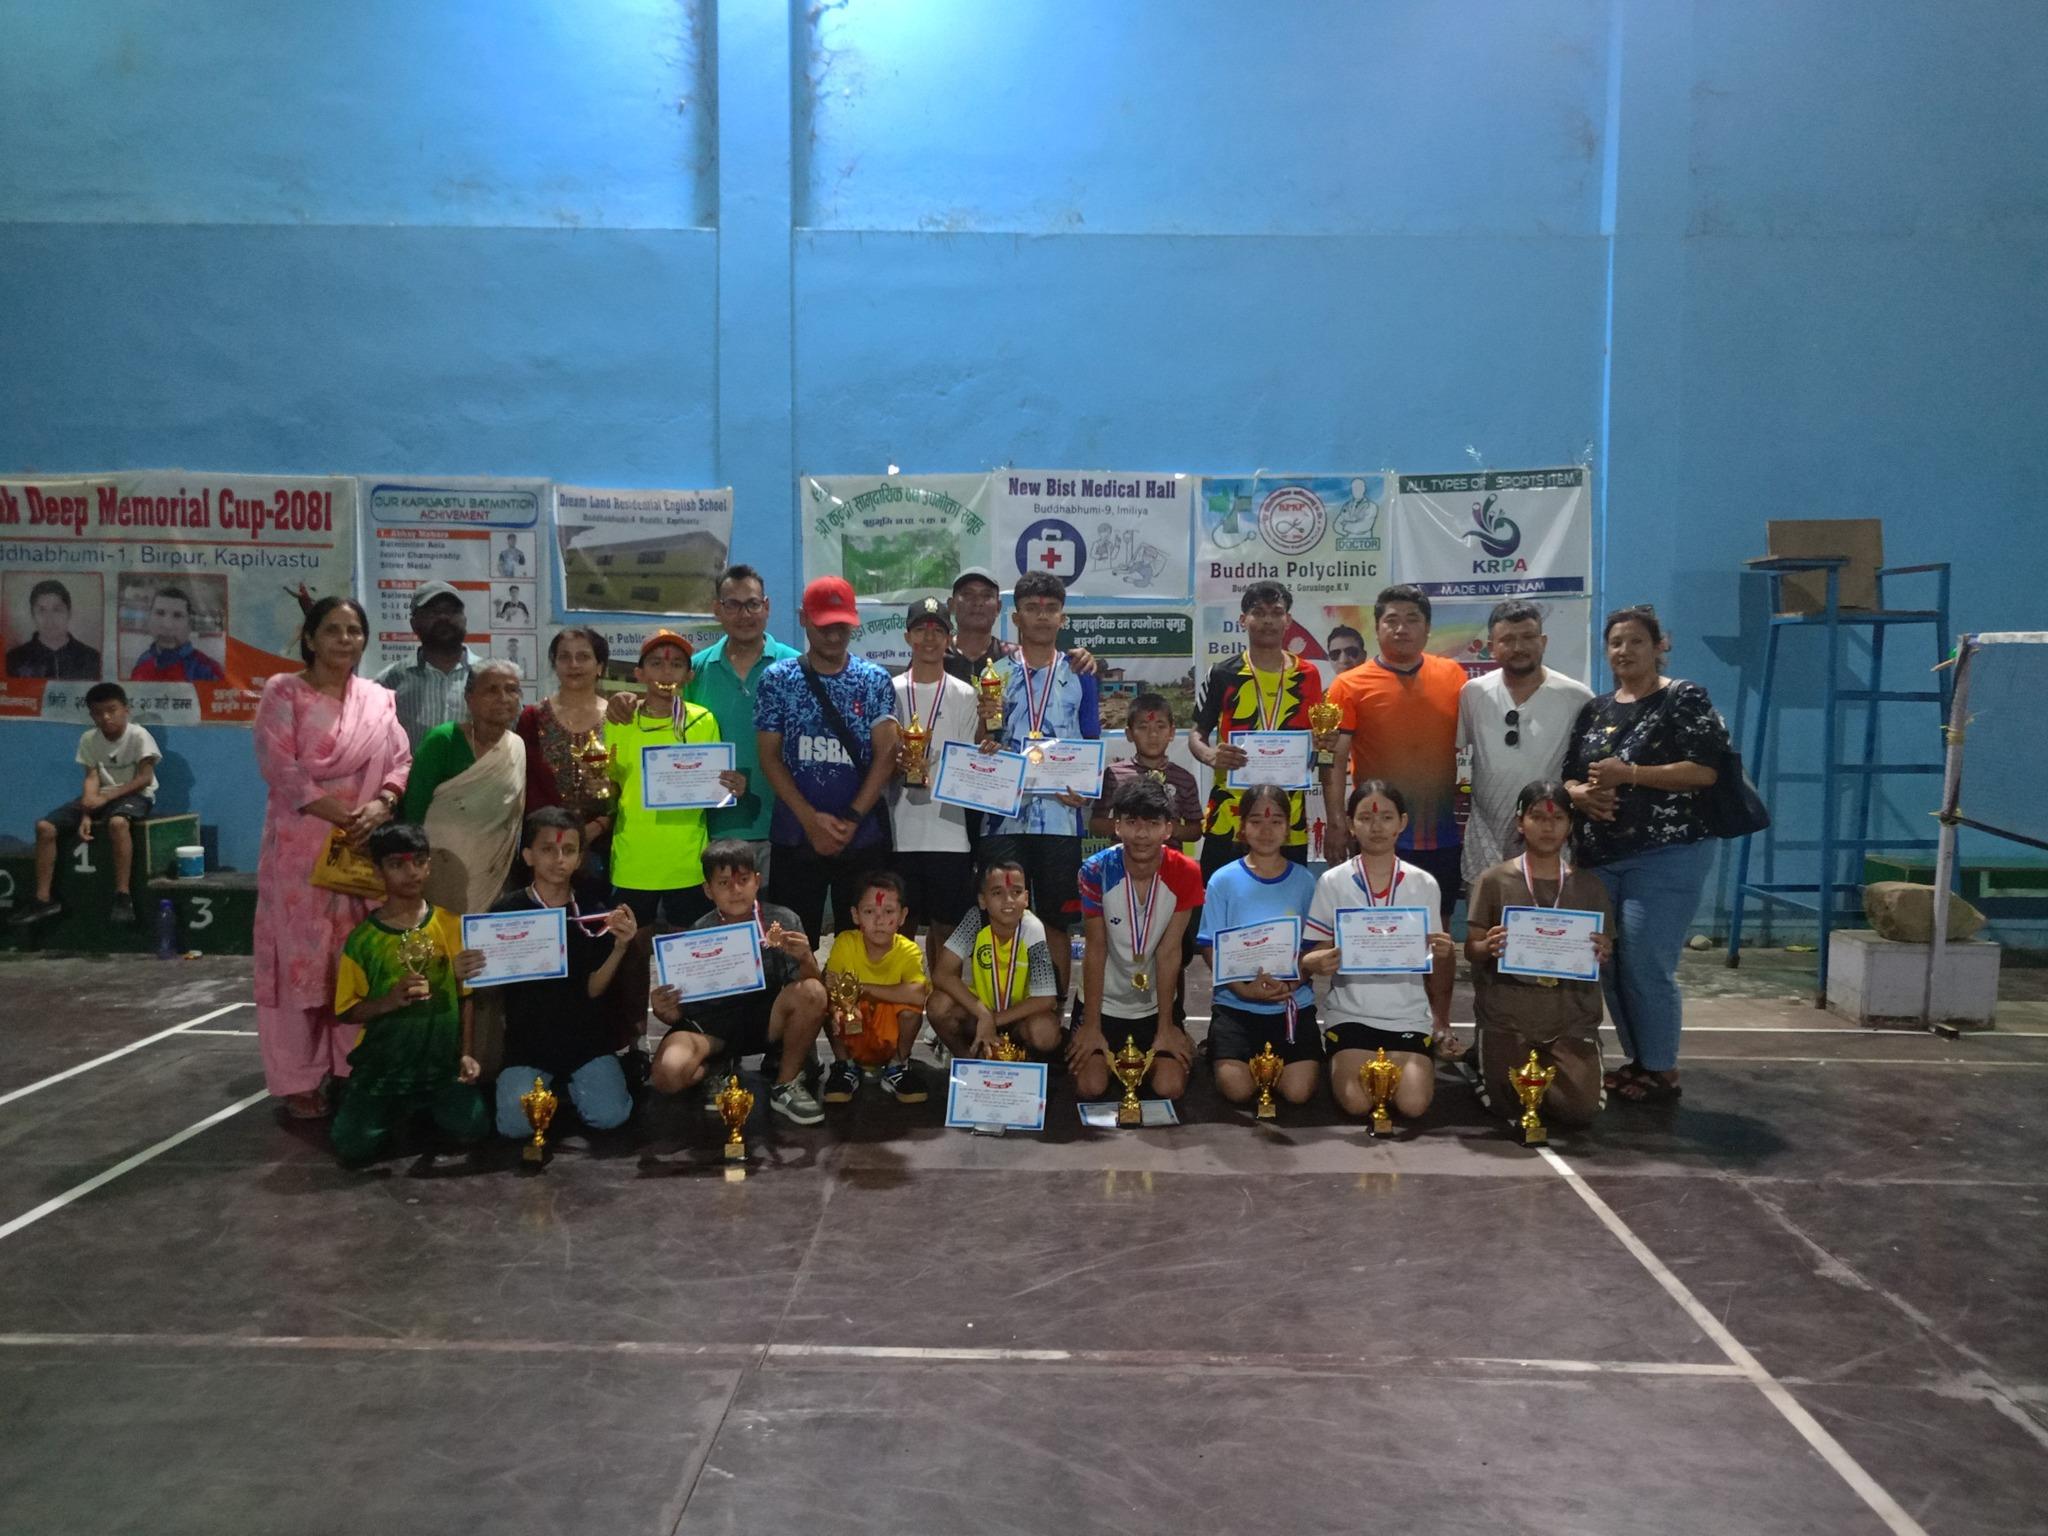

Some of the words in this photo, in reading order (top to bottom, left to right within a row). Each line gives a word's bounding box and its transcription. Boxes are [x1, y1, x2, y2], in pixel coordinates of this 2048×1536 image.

[1008, 478, 1041, 496] New
[1046, 478, 1076, 497] Bist
[1081, 479, 1141, 498] Medical
[1145, 480, 1176, 499] Hall
[1406, 481, 1428, 491] ALL
[1430, 478, 1468, 490] TYPES
[1470, 477, 1486, 489] OF
[1495, 475, 1545, 488] SPORTS
[1547, 473, 1575, 486] ITEM
[375, 496, 399, 508] OUR
[559, 493, 587, 508] Dream
[590, 495, 611, 509] Land
[664, 499, 697, 515] English
[698, 498, 727, 512] School
[1033, 503, 1115, 516] Buddhabhumi-9,
[1117, 506, 1149, 518] Imiliya
[24, 486, 89, 536] Deep
[97, 486, 210, 527] Memorial
[219, 488, 333, 539] Cup-2081
[420, 510, 491, 521] ACHIVEMENT
[141, 545, 207, 567] Birpur,
[215, 549, 320, 570] Kapilvastu
[1472, 558, 1528, 574] KRPA
[1210, 562, 1279, 578] Buddha
[1286, 560, 1377, 581] Polyclinic
[1441, 583, 1477, 595] MADE
[1478, 582, 1491, 594] IN
[1493, 581, 1546, 594] VIETNAM
[696, 631, 726, 642] Schoo
[72, 842, 97, 873] 1
[189, 896, 214, 929] 3
